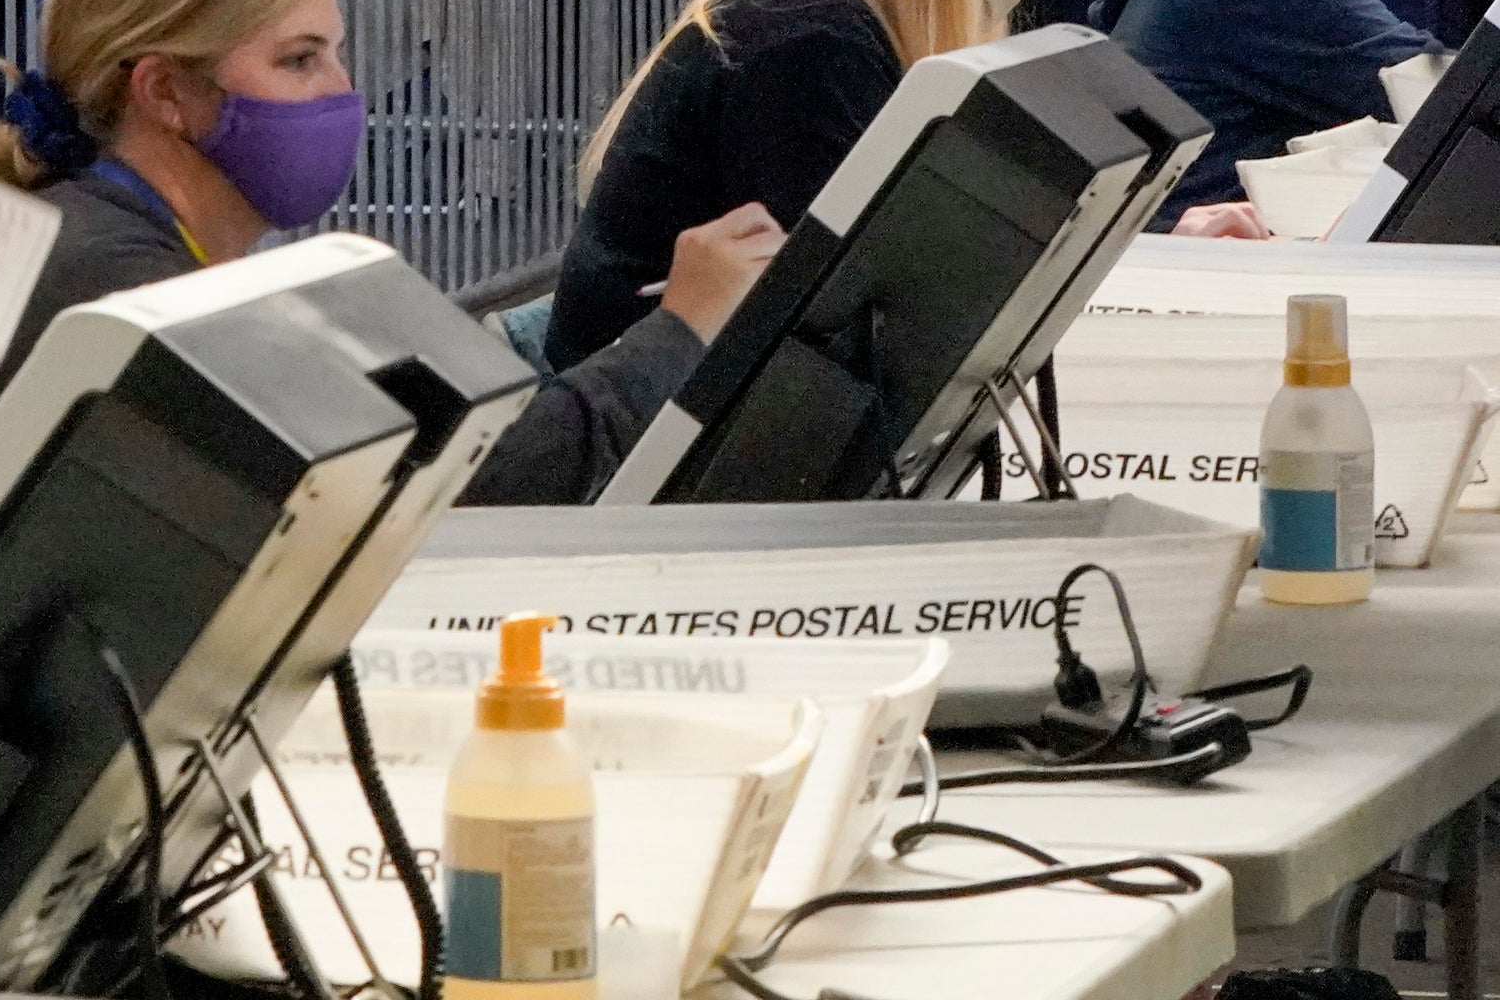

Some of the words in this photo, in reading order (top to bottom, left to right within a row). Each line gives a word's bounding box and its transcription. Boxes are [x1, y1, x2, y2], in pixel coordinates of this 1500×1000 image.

[1063, 452, 1176, 481] OSTAL
[748, 603, 902, 638] POSTAL
[914, 595, 1086, 634] SERVICE
